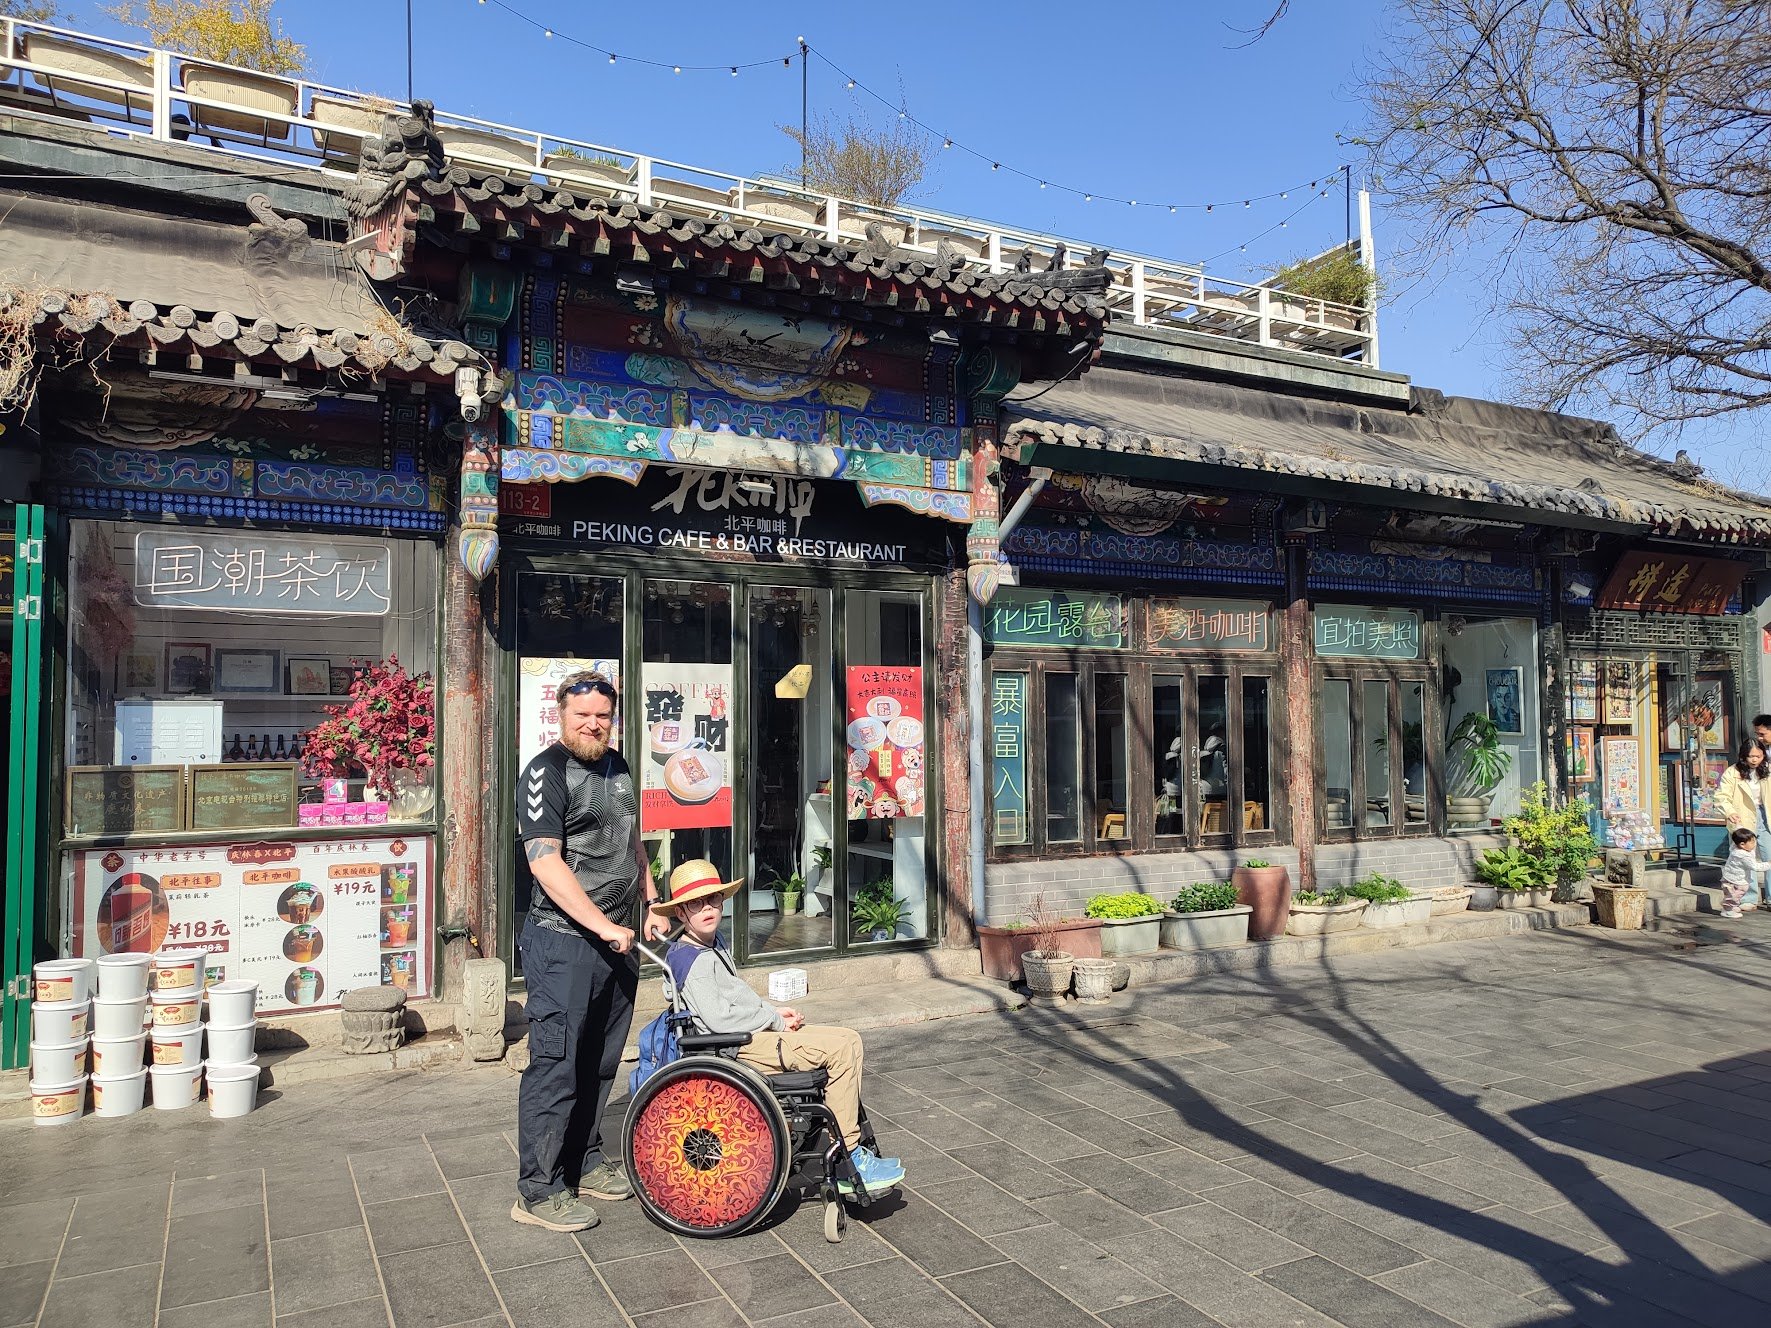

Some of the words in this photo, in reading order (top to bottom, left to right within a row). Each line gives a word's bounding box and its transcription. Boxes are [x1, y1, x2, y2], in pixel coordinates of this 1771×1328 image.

[501, 490, 540, 511] 113-2
[512, 523, 561, 536] 北平咖啡
[724, 515, 787, 535] 北平咖啡
[573, 520, 653, 545] PEKING
[658, 528, 711, 549] CAFE
[716, 532, 729, 551] &
[733, 534, 772, 553] BAR
[151, 544, 385, 602] 国潮茶饮
[986, 597, 1117, 640] 花园露台
[1151, 608, 1267, 644] 美酒咖啡
[1319, 616, 1415, 650] 宜拍美照
[862, 671, 912, 682] 公主请发财
[992, 678, 1022, 837] 暴富入口
[139, 850, 208, 862] 中华老字号
[312, 843, 370, 853] 百年庆林春
[107, 856, 120, 868] 茶
[169, 875, 213, 887] 北平往事
[250, 872, 291, 882] 北平咖啡
[333, 881, 376, 896] ¥19元
[168, 919, 231, 940] ¥18元
